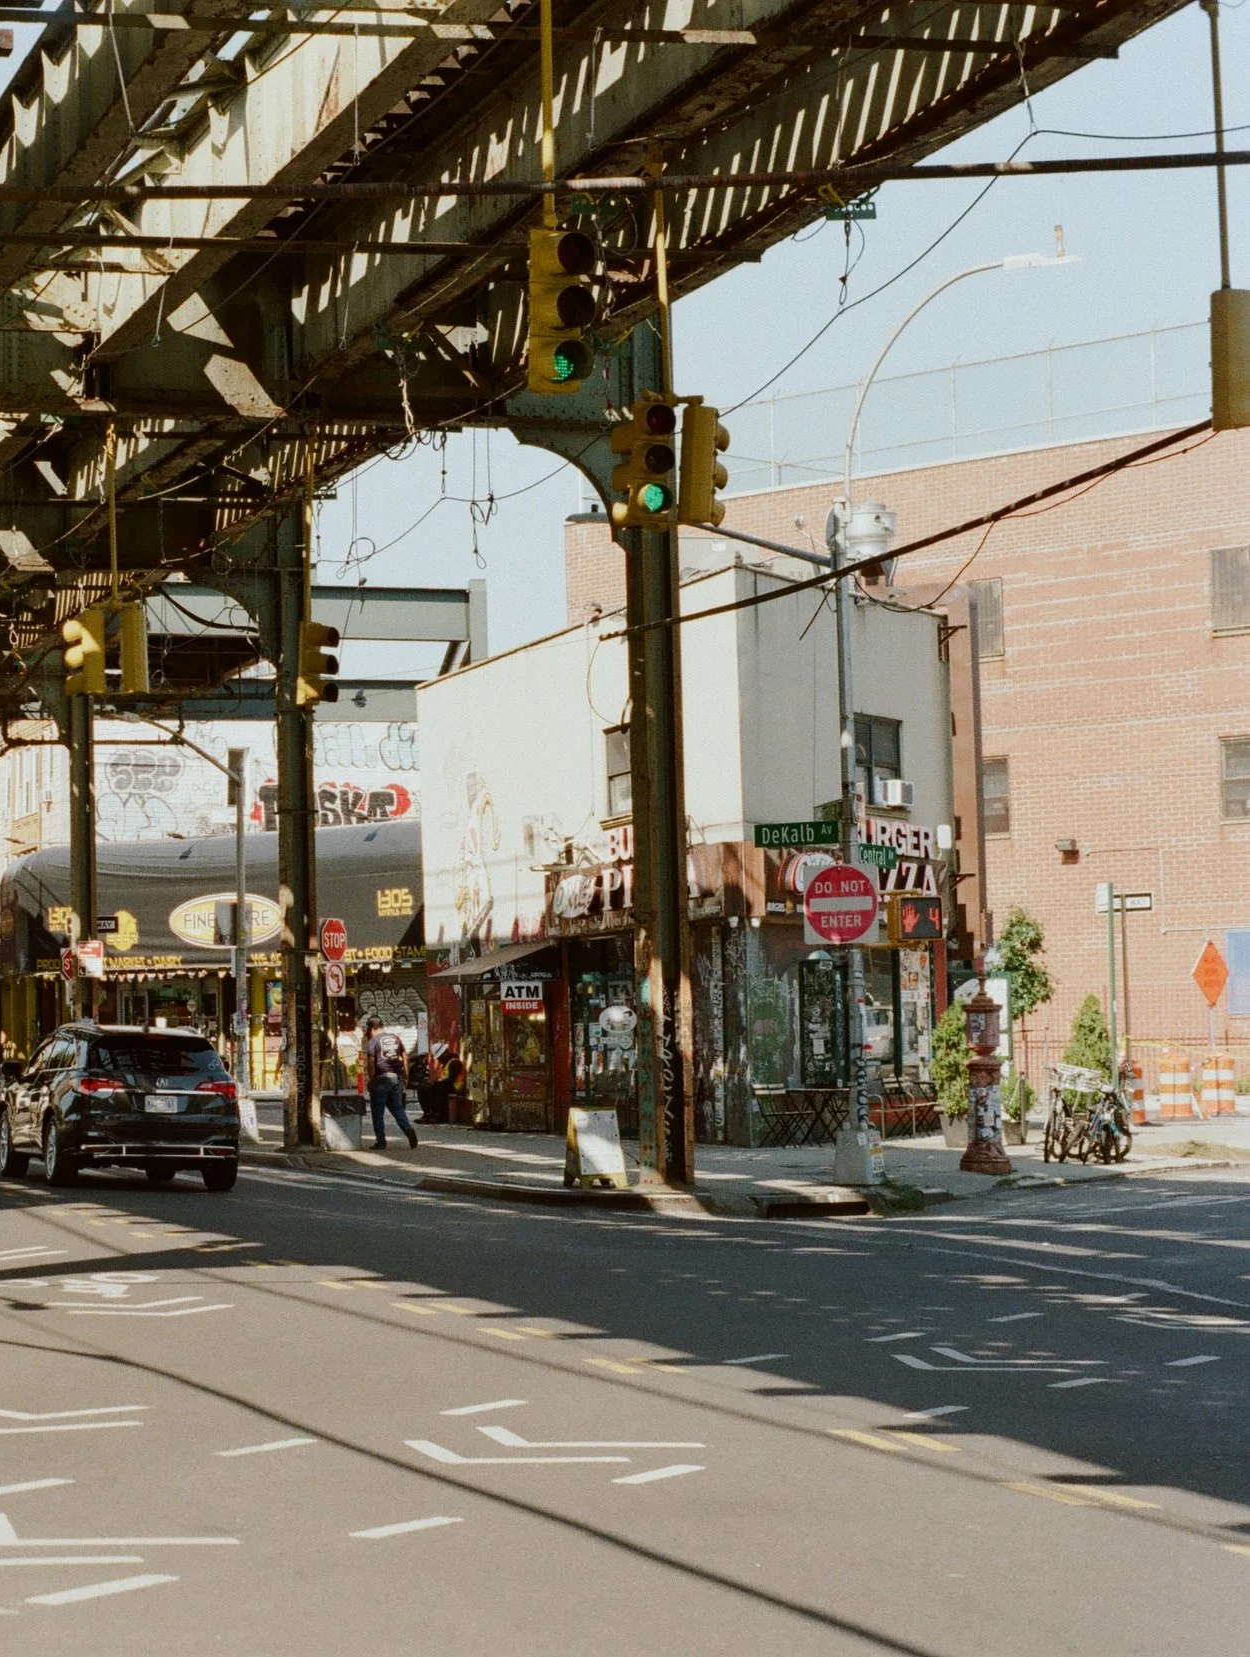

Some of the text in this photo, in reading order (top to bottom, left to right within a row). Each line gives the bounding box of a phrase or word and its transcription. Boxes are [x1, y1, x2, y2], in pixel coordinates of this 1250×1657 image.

[762, 824, 832, 844] DeKalb Av
[859, 846, 886, 865] Central
[815, 880, 866, 894] DO NOT
[878, 861, 938, 903] ZZA
[378, 888, 413, 908] 1305
[183, 912, 215, 929] FINE
[821, 915, 862, 928] ENTER
[929, 907, 940, 931] 4
[324, 932, 345, 948] STOP
[108, 957, 145, 967] MARKET
[153, 955, 182, 965] DAIRY
[365, 947, 392, 960] FOOD
[505, 985, 539, 998] ATM
[506, 1001, 538, 1010] INSIDE
